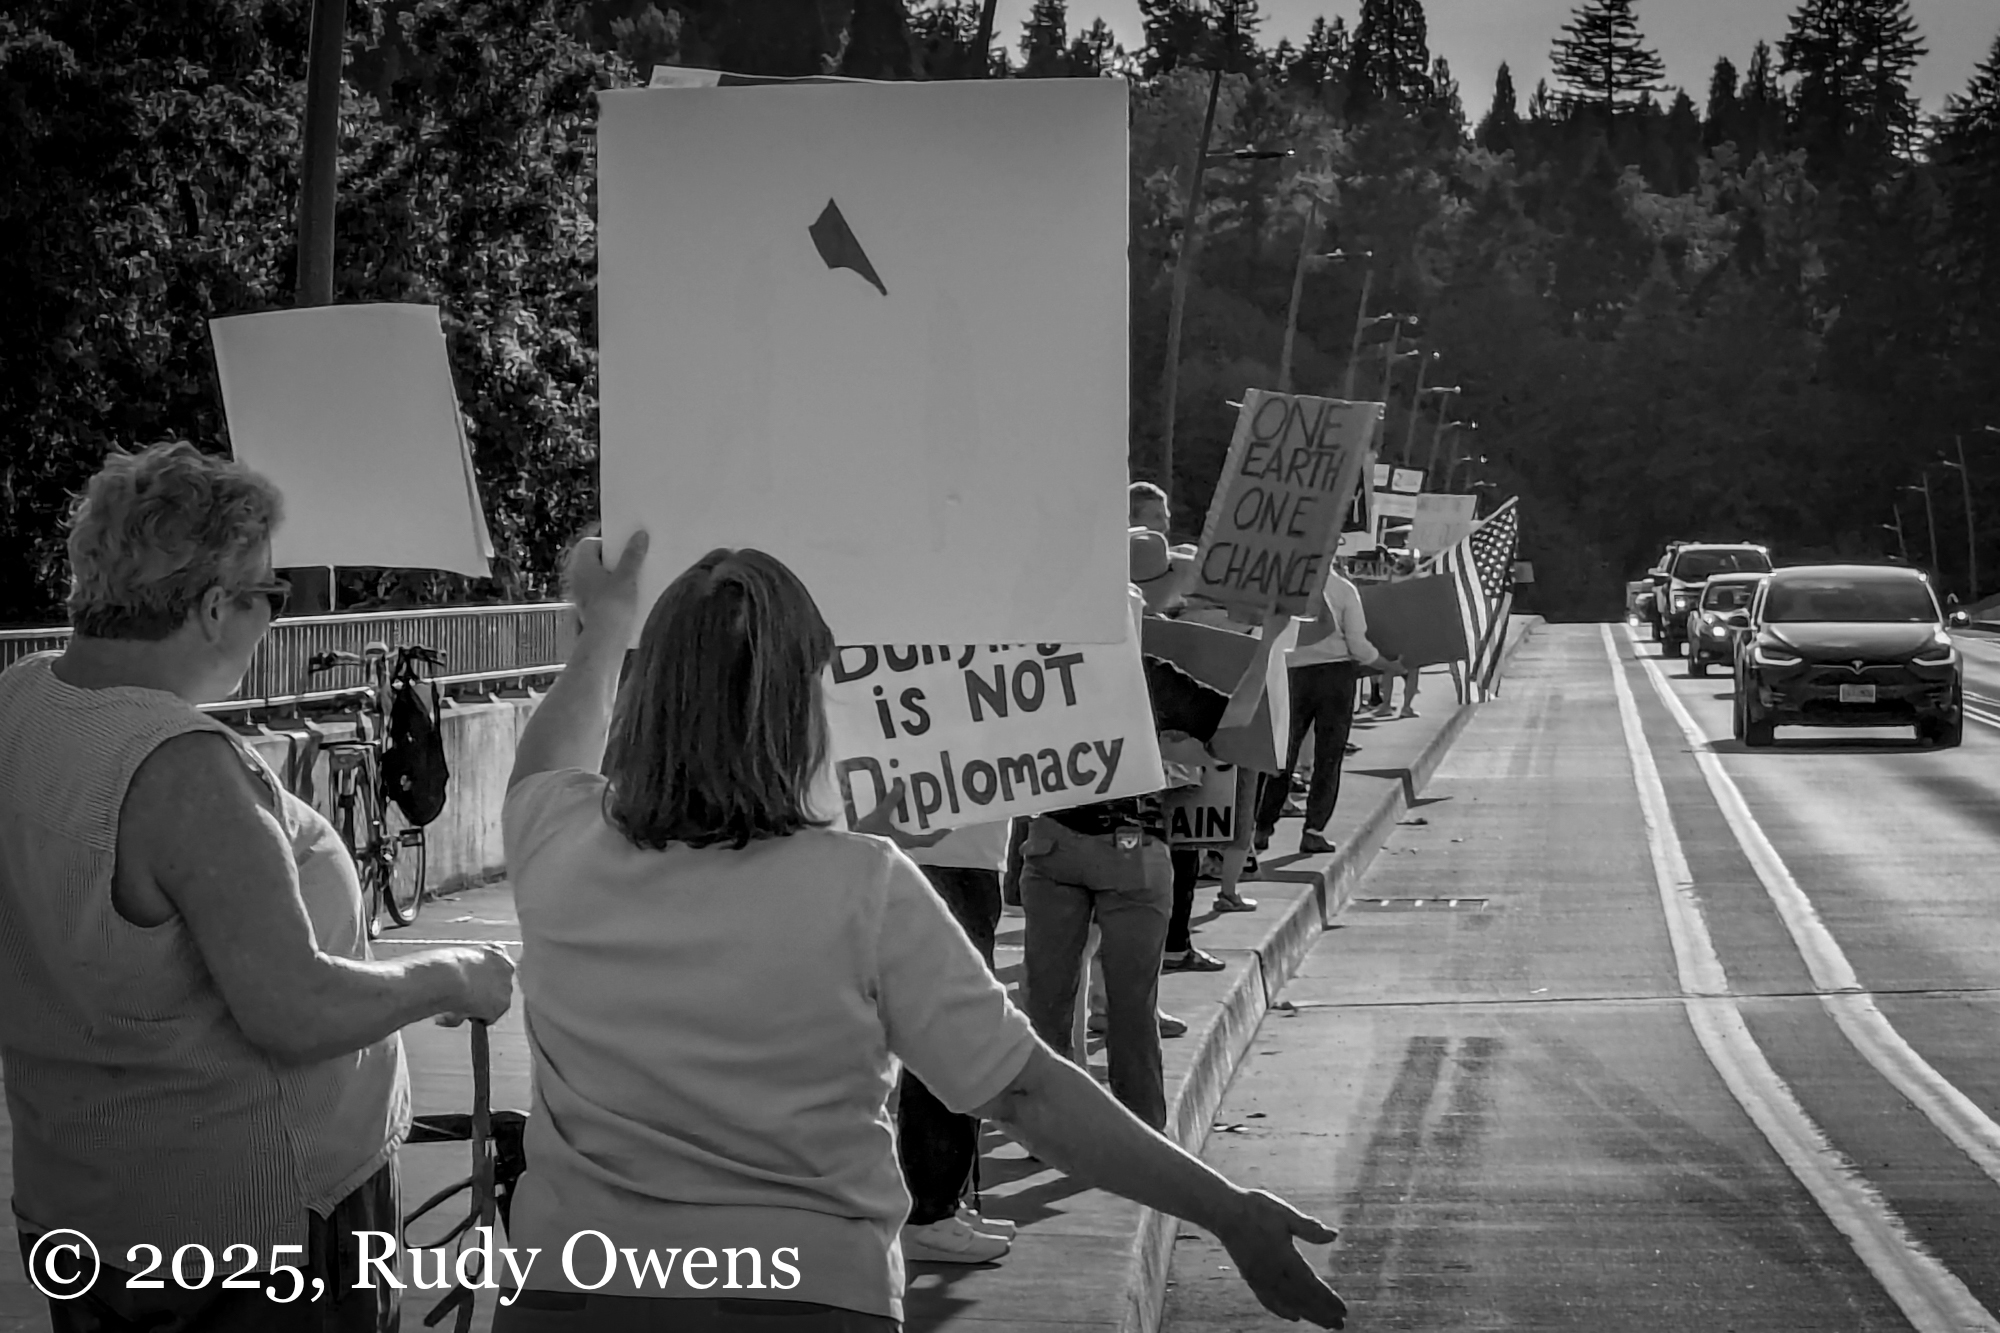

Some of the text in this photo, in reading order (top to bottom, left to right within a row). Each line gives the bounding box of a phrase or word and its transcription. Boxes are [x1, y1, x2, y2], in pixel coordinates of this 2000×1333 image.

[1252, 396, 1352, 450] ONE
[1241, 442, 1346, 492] EARTH
[1234, 487, 1318, 536] ONE
[1201, 542, 1323, 597] CHANCE
[873, 685, 931, 739] is
[964, 652, 1084, 722] NOT
[835, 737, 1124, 831] Diplomacy
